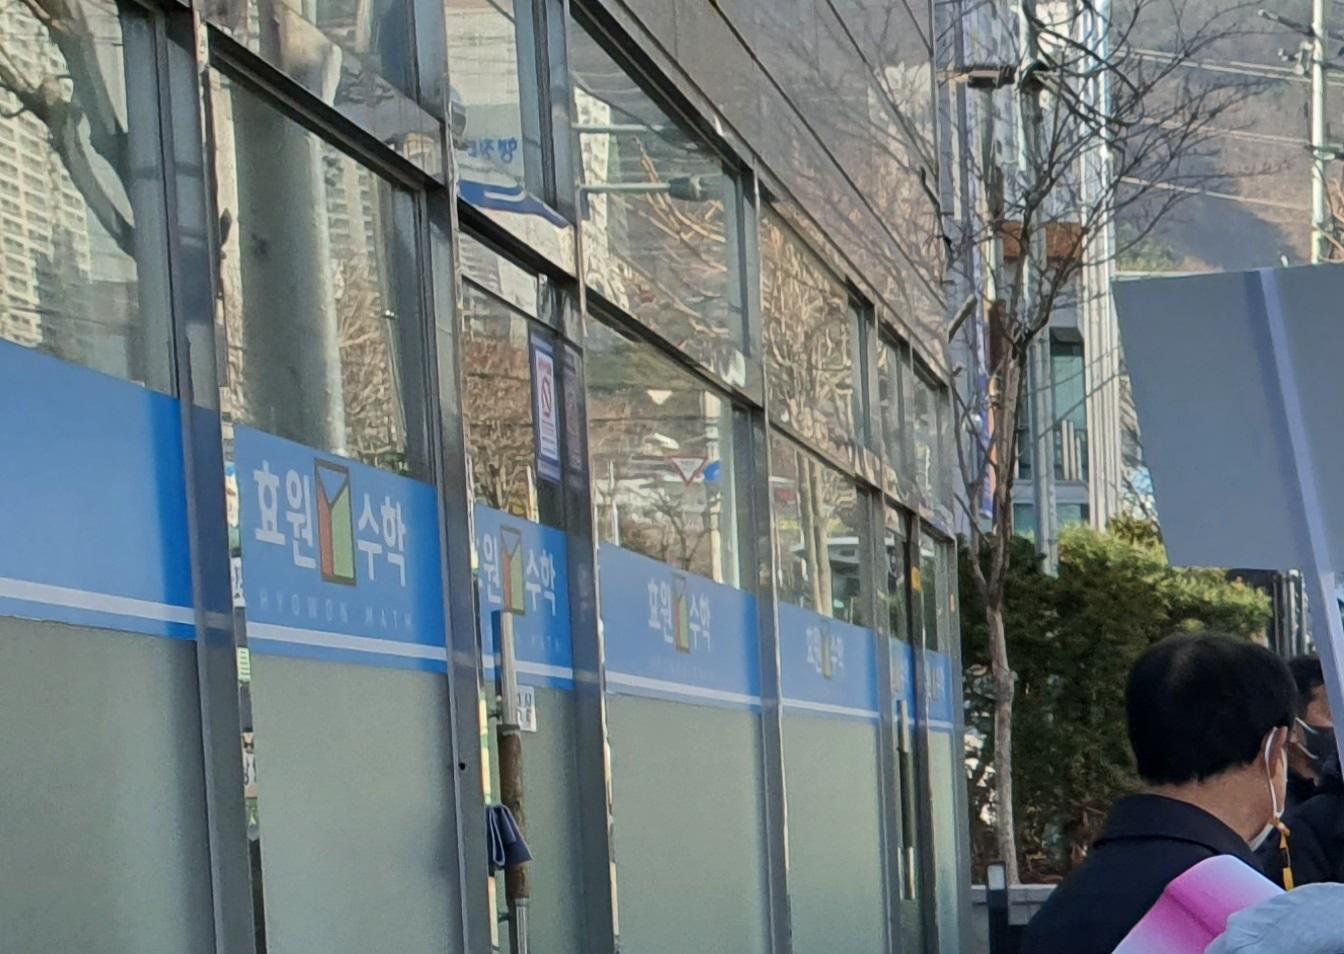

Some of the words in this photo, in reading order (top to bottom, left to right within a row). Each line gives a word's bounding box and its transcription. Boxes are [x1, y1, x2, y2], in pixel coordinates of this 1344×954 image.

[253, 461, 316, 570] 효원
[356, 492, 408, 587] 수학
[258, 589, 349, 624] HYOWON
[364, 606, 413, 631] MATH
[477, 533, 502, 605] 원
[526, 547, 556, 617] 수학
[647, 577, 673, 644] 효원
[689, 592, 711, 653] 수학
